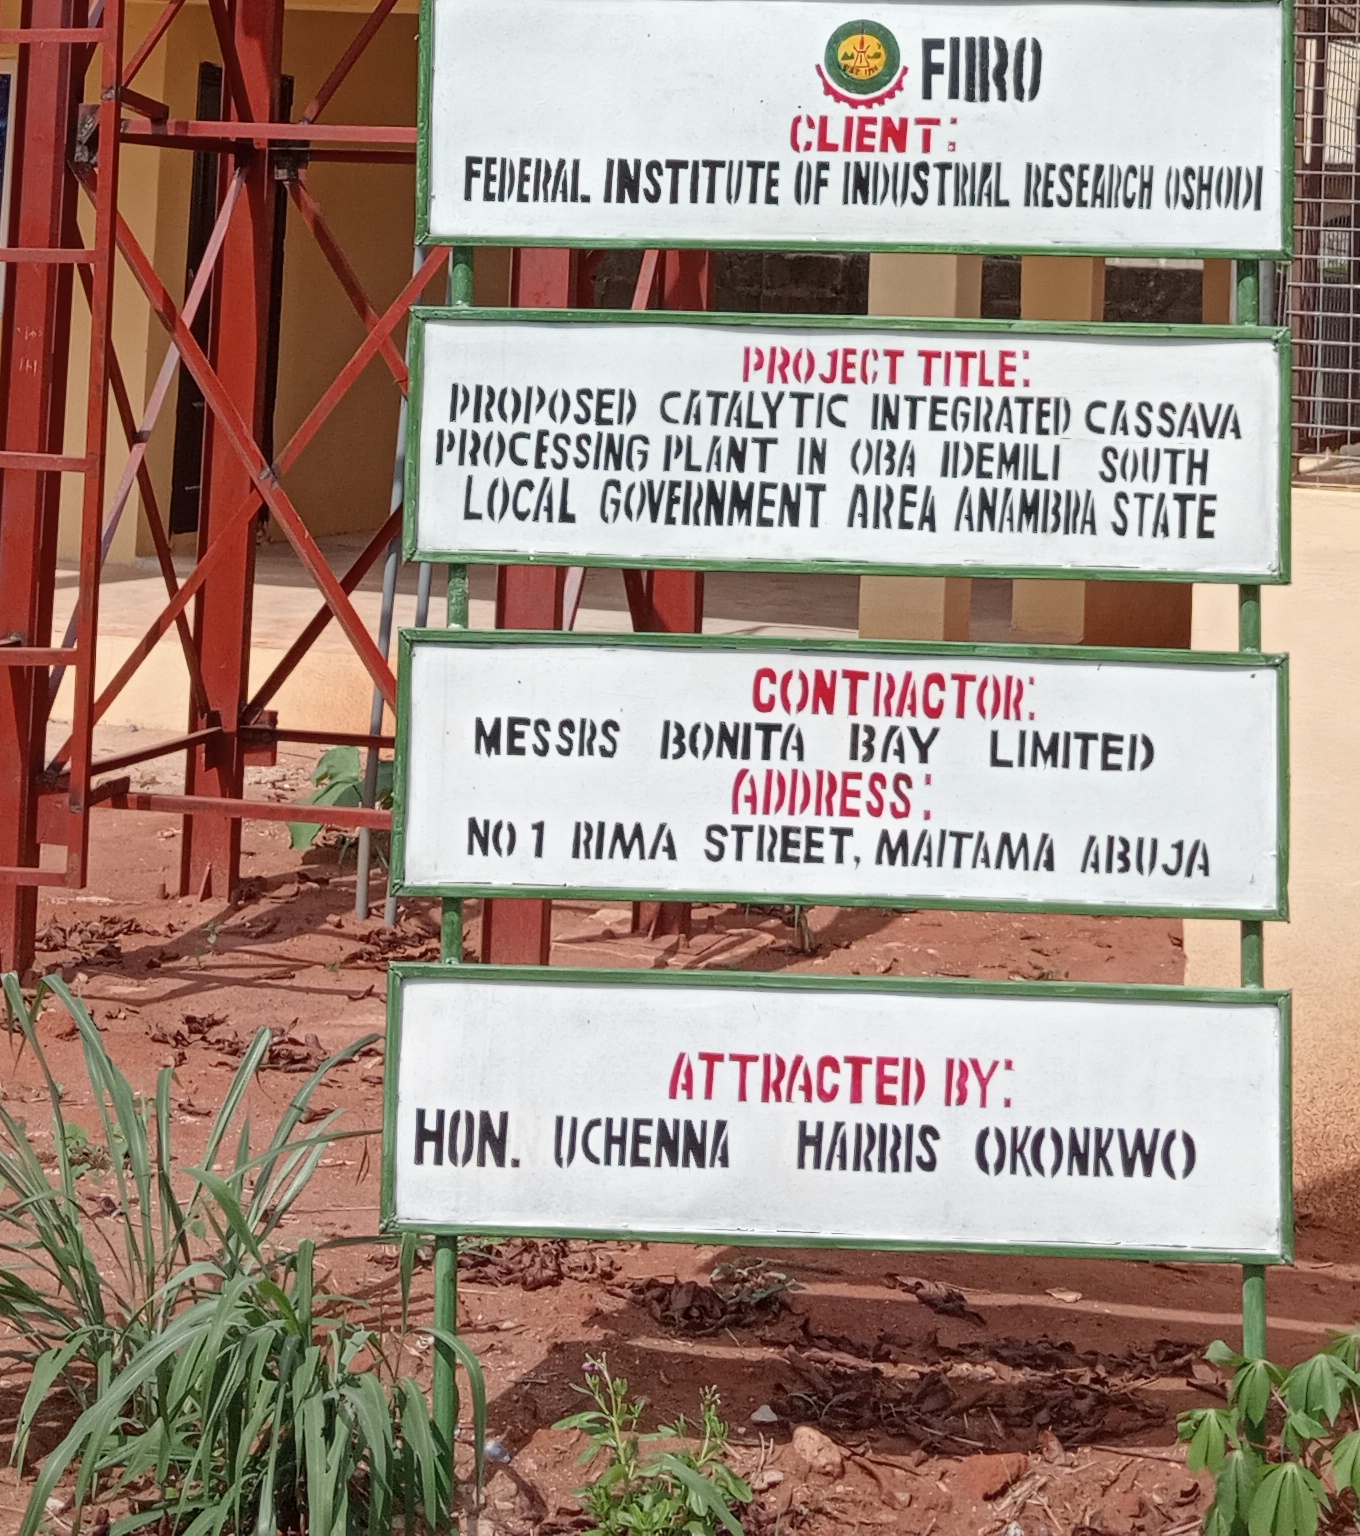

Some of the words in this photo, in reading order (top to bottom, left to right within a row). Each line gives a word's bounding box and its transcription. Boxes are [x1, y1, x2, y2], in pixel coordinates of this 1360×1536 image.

[922, 36, 1043, 103] FIIRO
[464, 155, 591, 203] FEDERAL
[603, 157, 780, 206] INSTITUTE
[794, 160, 830, 205] OF
[842, 161, 1010, 207] INDUSTRIAL
[1024, 162, 1154, 210] RESEARCH
[1165, 166, 1263, 211] OSHODI
[743, 346, 905, 384] PROJECT
[918, 349, 1031, 388] TITLE:
[449, 383, 637, 426] PROPOSED
[660, 389, 848, 430] CATALYTIC
[871, 393, 1071, 436] INTEGRATED
[1085, 400, 1242, 440] CASSAVA
[435, 428, 650, 472] PROCESSING
[663, 435, 778, 474] PLANT
[797, 437, 827, 475] IN
[851, 439, 915, 478] OBA
[940, 441, 1060, 481] IDEMILI
[1099, 446, 1209, 486] SOUTH
[463, 474, 576, 524] LOCAL
[600, 479, 827, 528] GOVERNMENT
[847, 484, 936, 533] AREA
[954, 486, 1097, 536] ANAMBRA
[1112, 491, 1217, 539] STATE
[752, 666, 1036, 721] CONTRACTOR:
[475, 716, 621, 759] MESSRS
[660, 720, 804, 762] BONITA
[849, 723, 940, 764] BAY
[990, 730, 1155, 771] LIMITED
[467, 817, 516, 857] NO
[531, 820, 545, 858] 1
[571, 820, 677, 861] RIMA
[704, 824, 860, 869] STREET,
[875, 829, 1055, 872] MAITAMA
[1080, 835, 1210, 878] ABUJA
[669, 1051, 926, 1106] ATTRACTED
[945, 1058, 1013, 1108] BY:
[414, 1108, 520, 1168] HON.
[554, 1115, 729, 1169] UCHENNA
[797, 1120, 941, 1173] HARRIS
[975, 1126, 1196, 1180] OKONKWO
